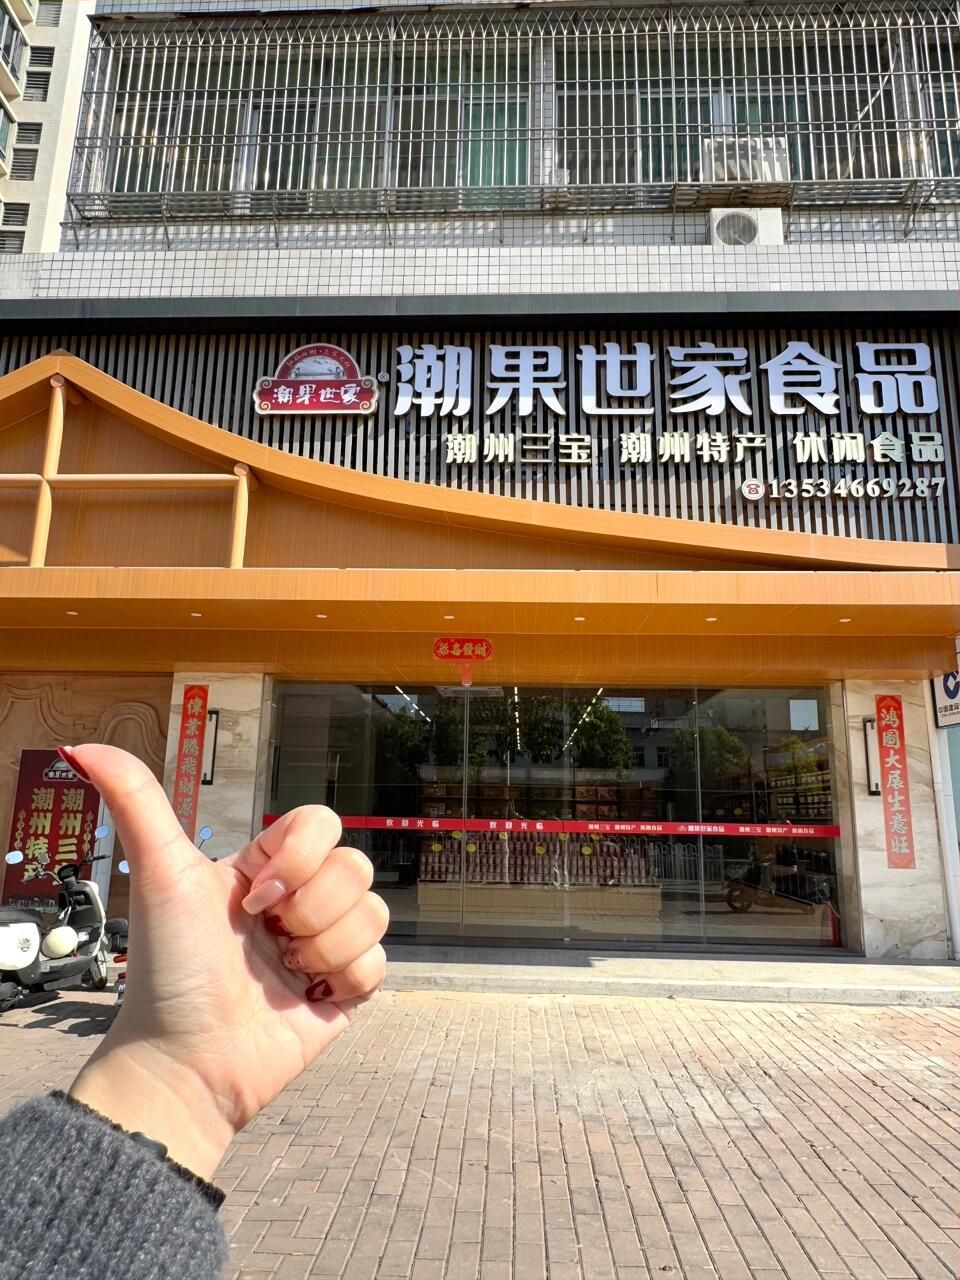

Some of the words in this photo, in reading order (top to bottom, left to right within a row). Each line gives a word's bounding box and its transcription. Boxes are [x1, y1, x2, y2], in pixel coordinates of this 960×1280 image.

[394, 340, 940, 417] 潮果世家食品
[271, 384, 362, 405] 潮果世家
[446, 432, 592, 464] 潮州三宝
[619, 431, 767, 464] 潮州特产
[794, 430, 945, 464] 休闲食品
[768, 476, 946, 499] 13534669287
